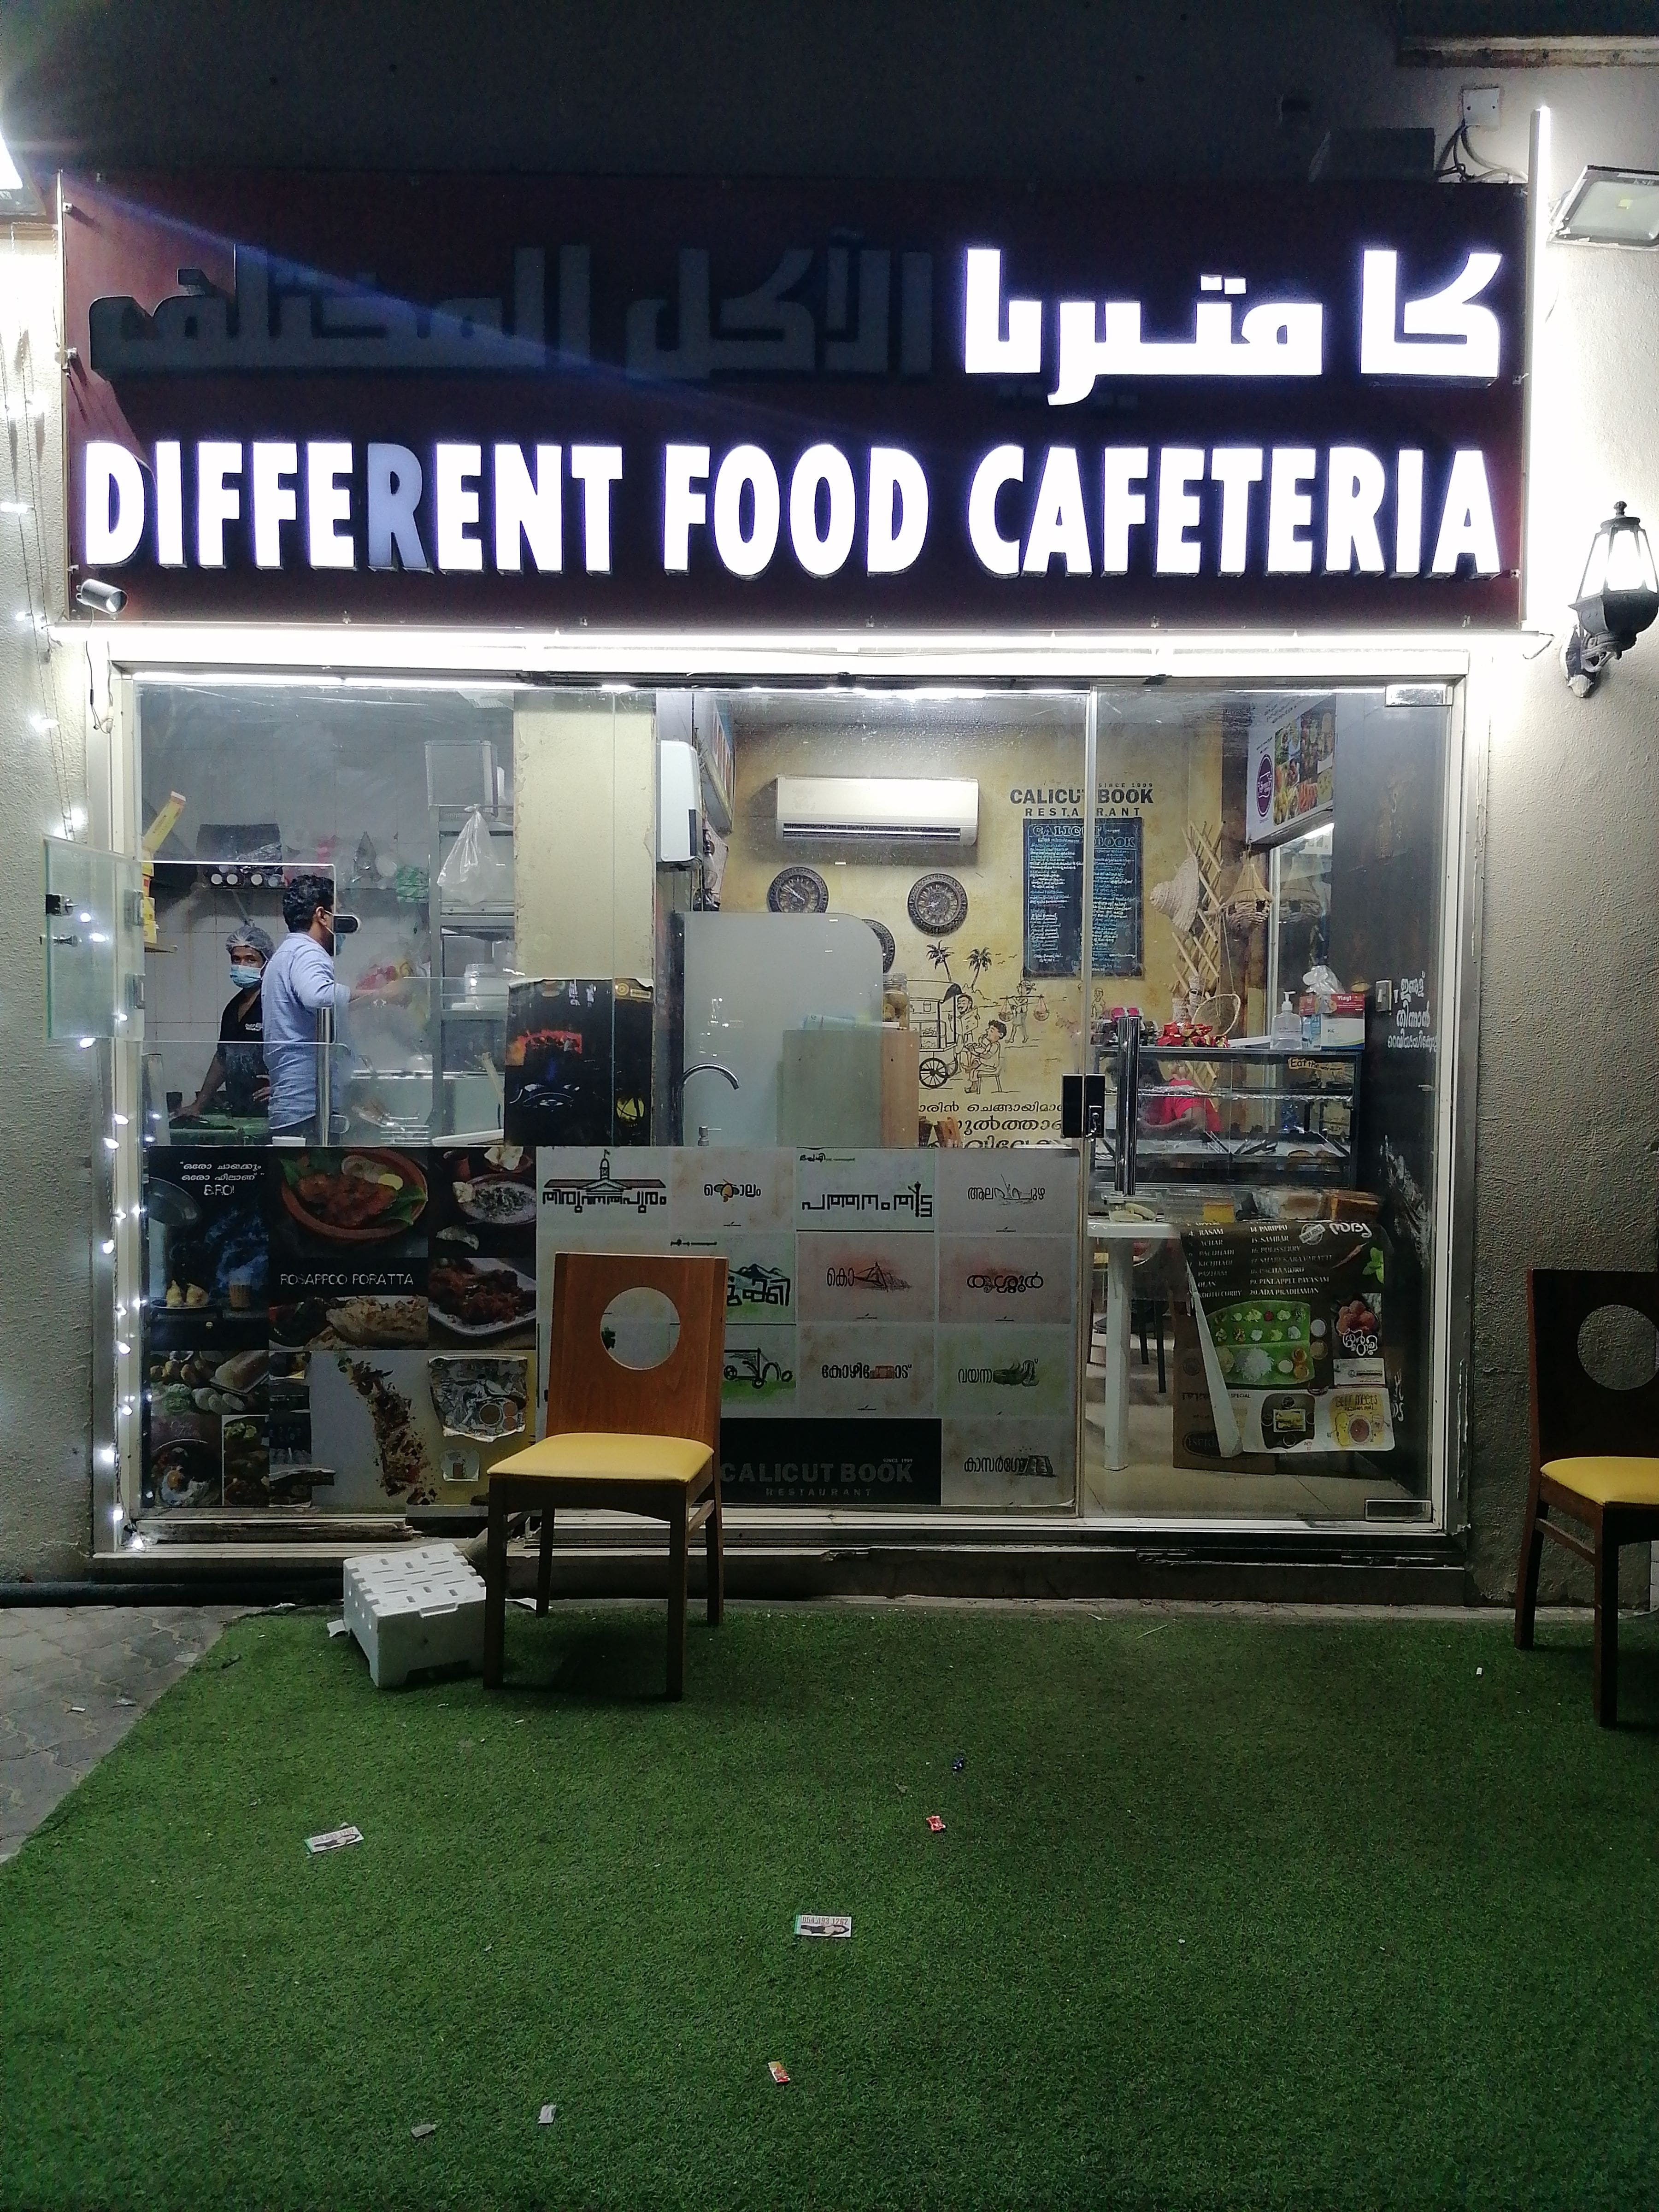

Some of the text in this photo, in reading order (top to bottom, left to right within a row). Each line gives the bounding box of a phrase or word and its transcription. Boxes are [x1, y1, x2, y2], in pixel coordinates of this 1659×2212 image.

[85, 438, 1500, 576] DIFFERENT FOOD CAFETERIA
[1097, 788, 1154, 804] BOOK
[1025, 808, 1140, 817] RESTARANT
[1290, 1058, 1306, 1067] Eat
[1260, 1235, 1289, 1243] SAMBAR
[352, 1273, 414, 1285] PORATTA
[720, 1462, 913, 1483] CALICUT BOOK
[765, 1488, 872, 1496] RESTAURANT
